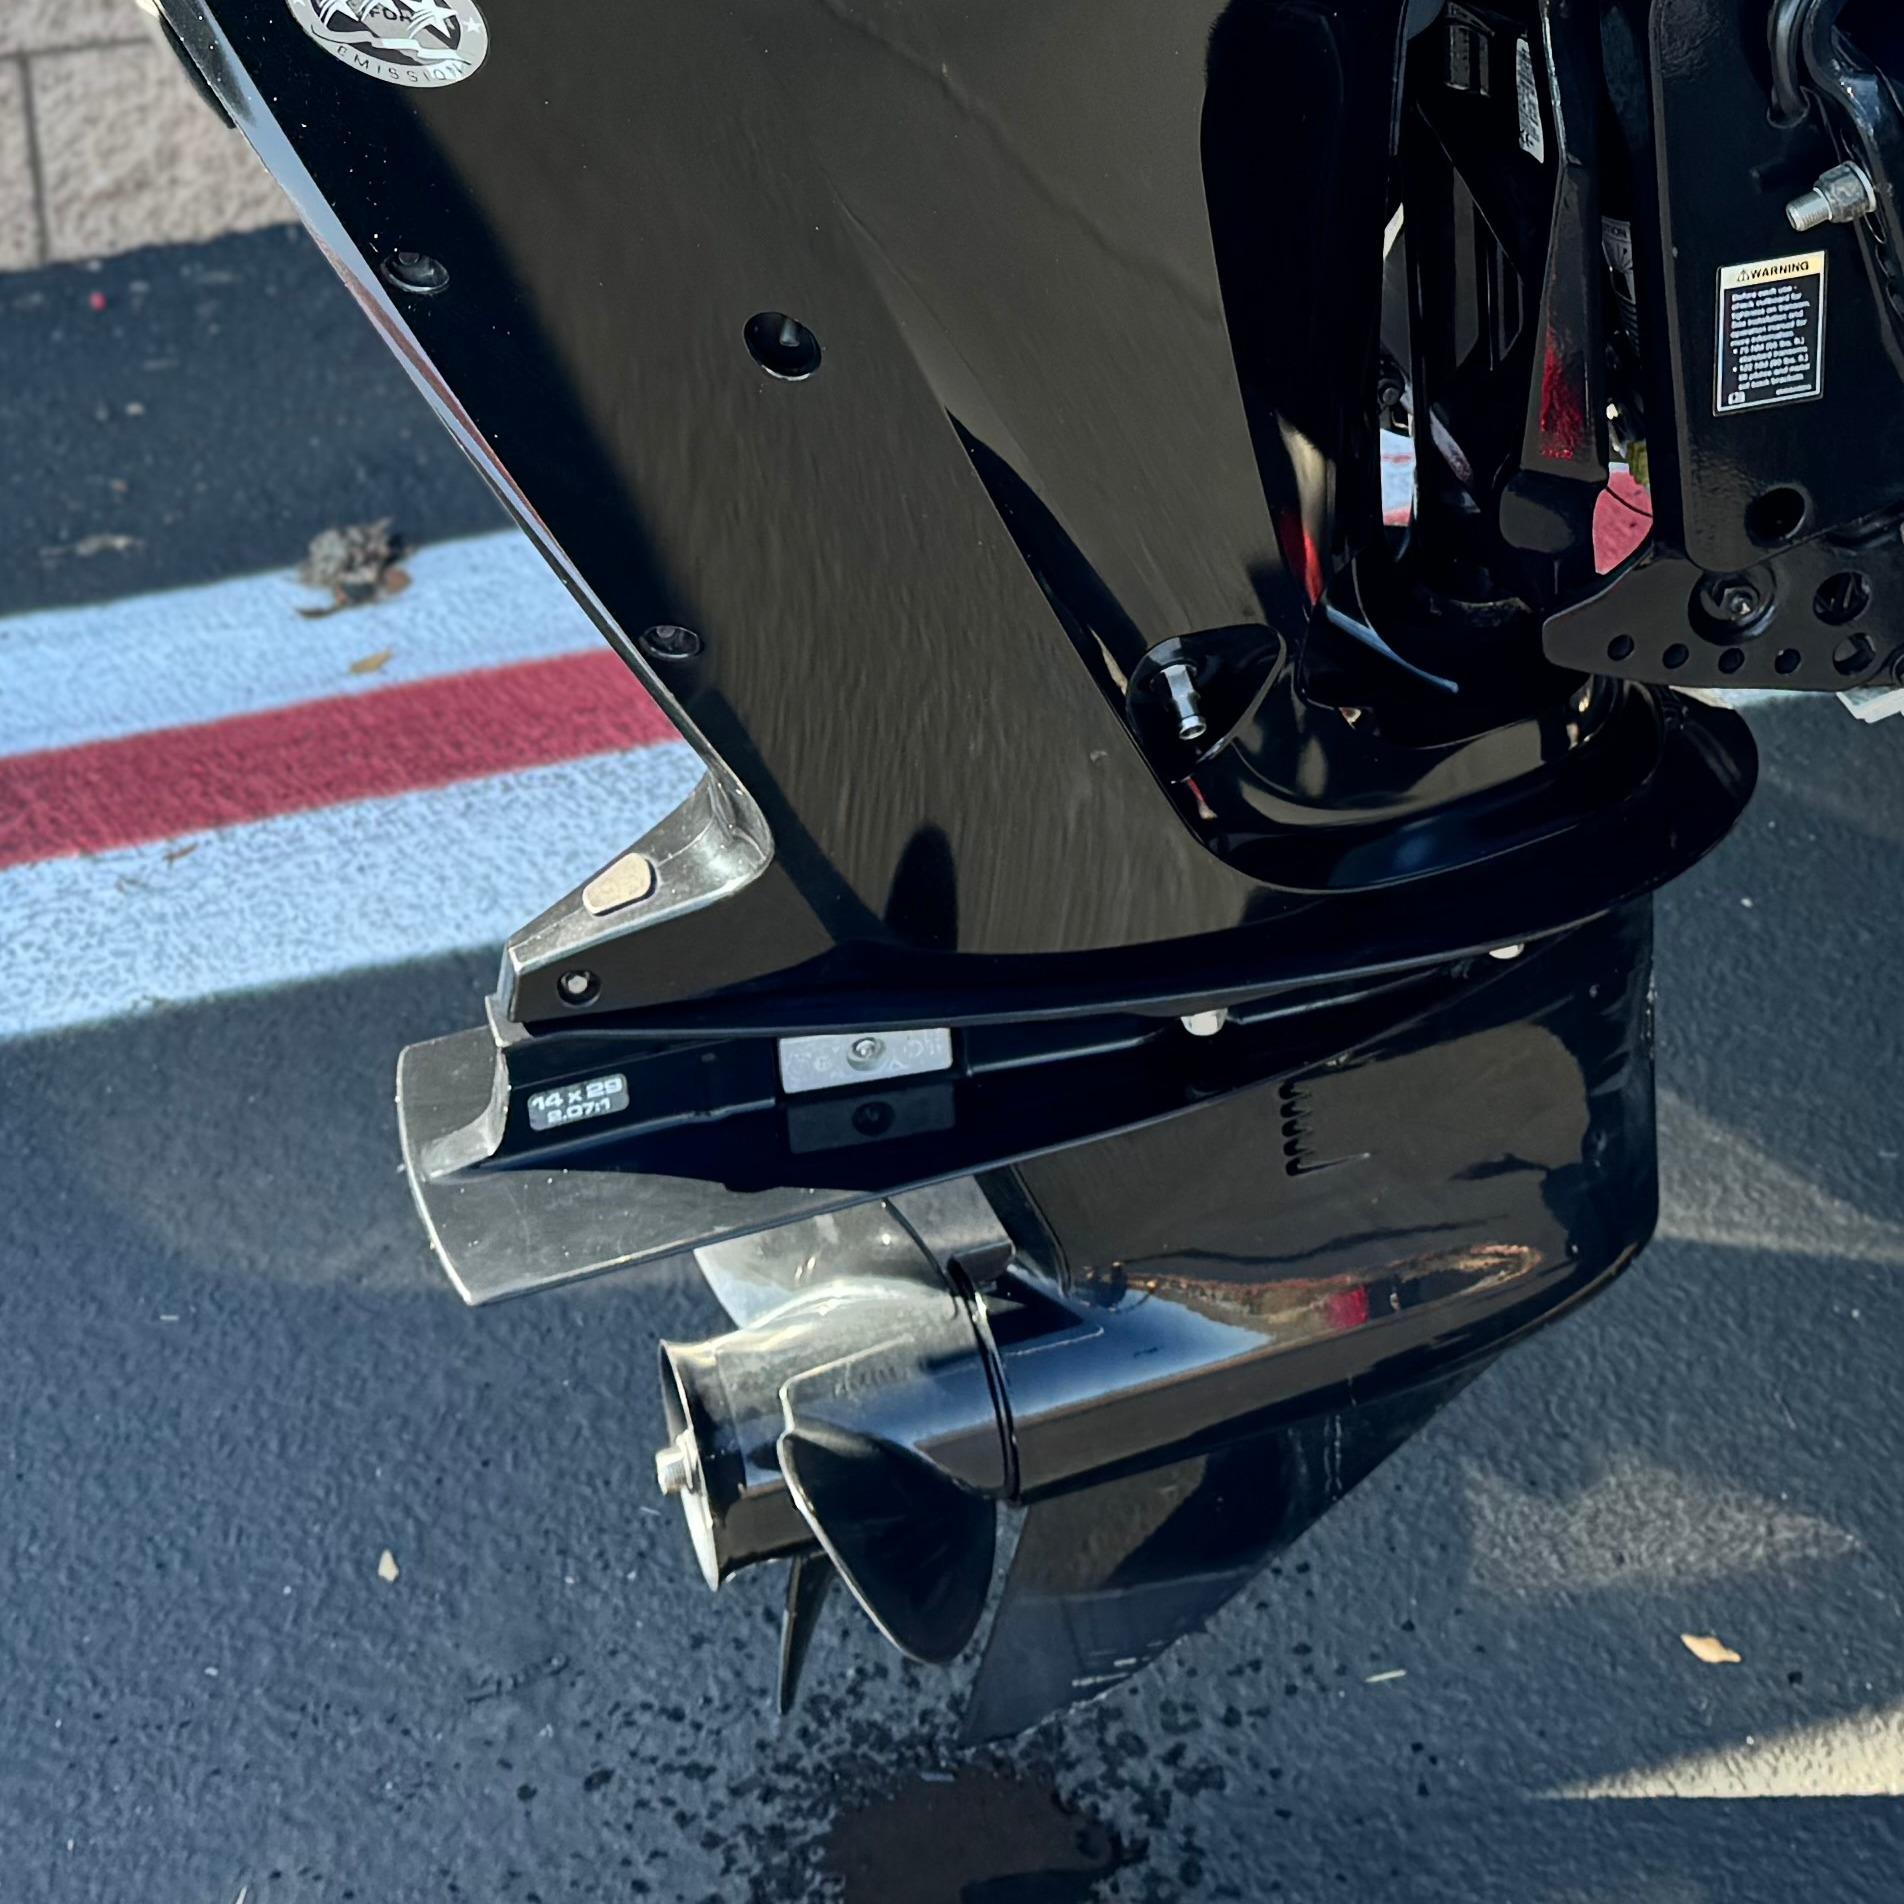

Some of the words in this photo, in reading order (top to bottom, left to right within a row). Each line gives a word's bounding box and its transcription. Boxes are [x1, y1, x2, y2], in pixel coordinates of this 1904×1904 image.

[337, 46, 463, 82] EMISSION
[1749, 261, 1809, 280] WARNING
[532, 1092, 563, 1110] 14
[586, 1078, 623, 1099] 29
